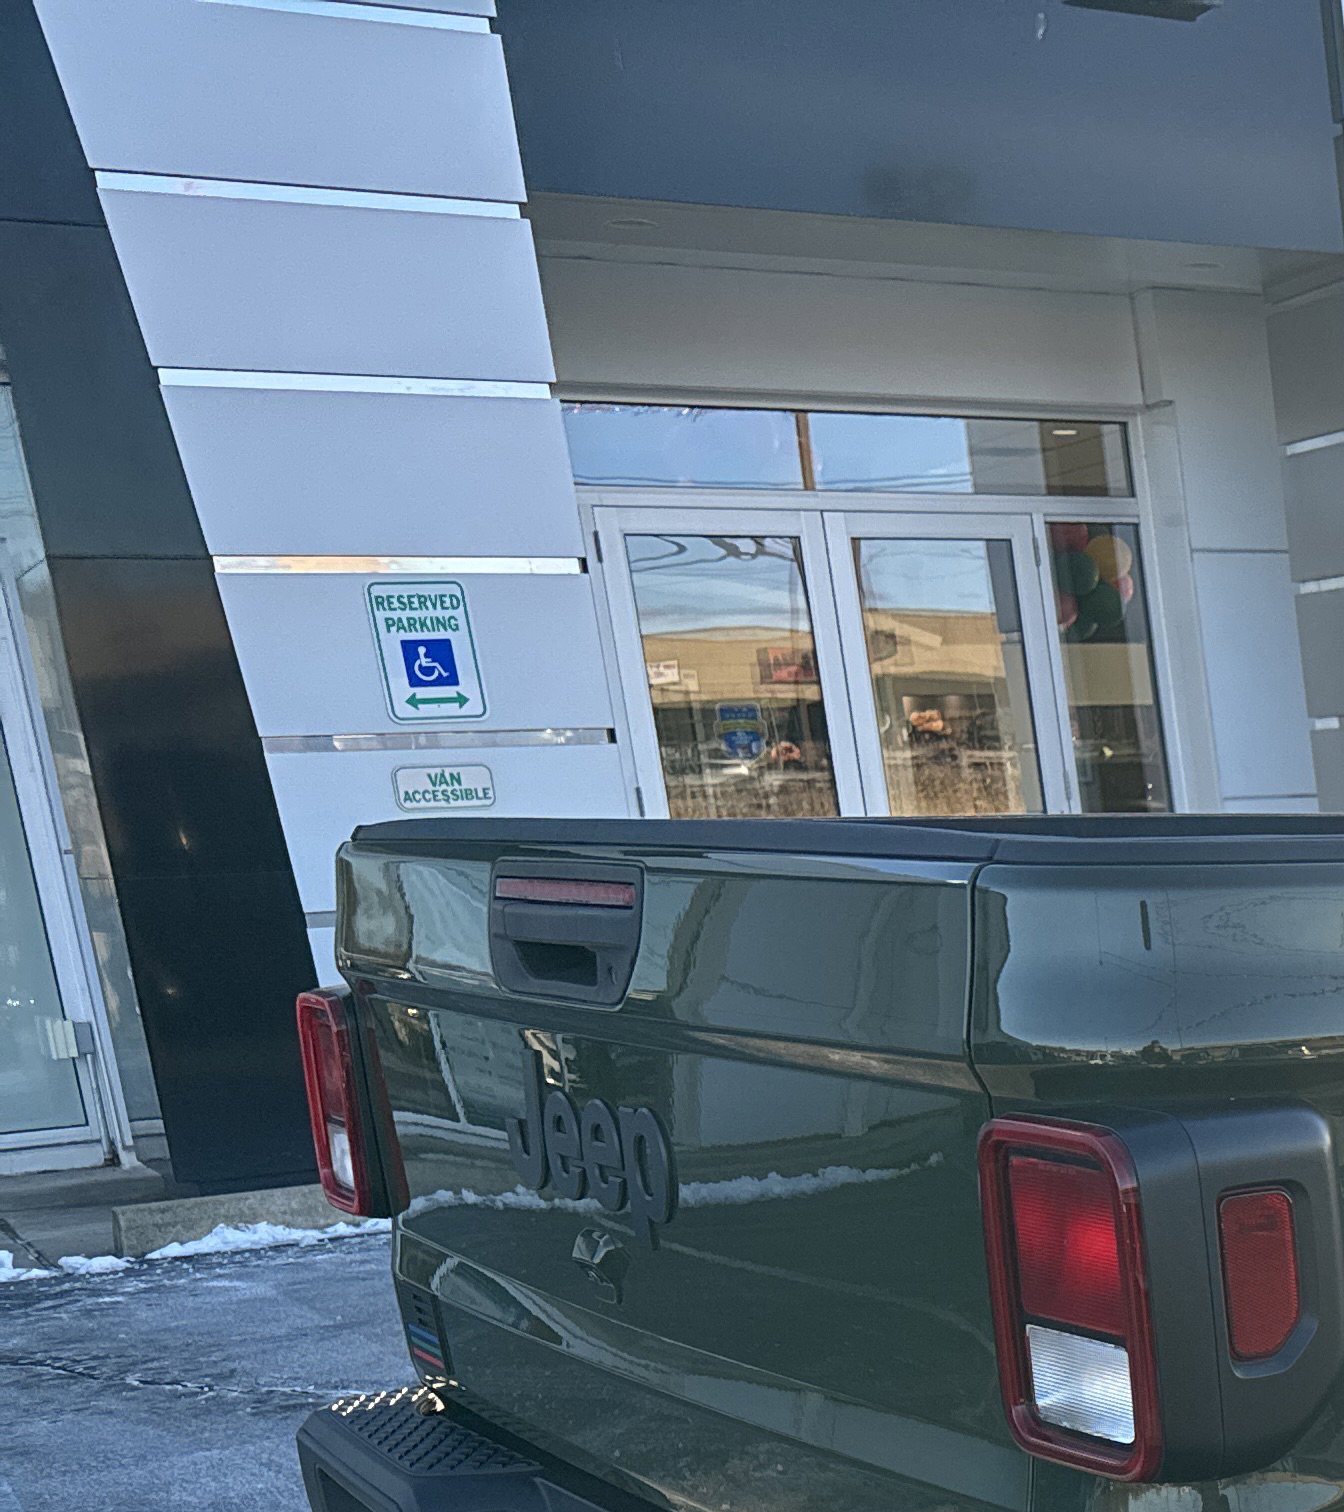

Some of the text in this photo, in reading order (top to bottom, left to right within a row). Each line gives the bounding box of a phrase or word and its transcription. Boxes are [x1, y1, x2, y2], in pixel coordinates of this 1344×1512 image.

[374, 593, 461, 611] RESERVED
[384, 615, 460, 634] PARKING
[427, 771, 462, 788] VAN
[403, 787, 493, 804] ACCESSIBLE
[505, 1046, 680, 1251] Jeep
